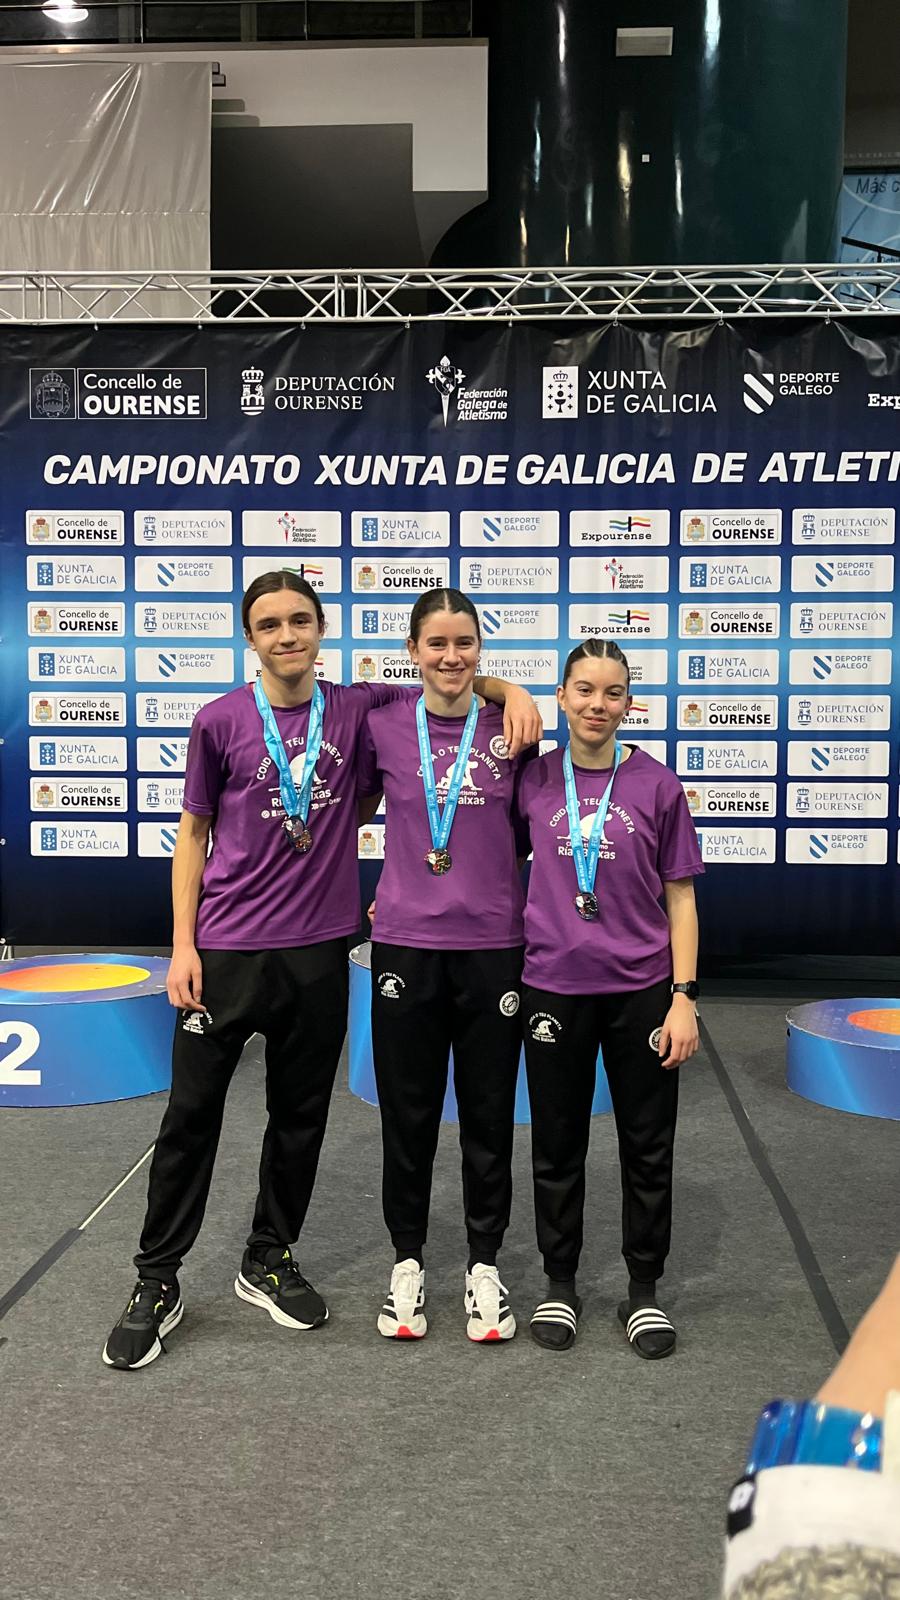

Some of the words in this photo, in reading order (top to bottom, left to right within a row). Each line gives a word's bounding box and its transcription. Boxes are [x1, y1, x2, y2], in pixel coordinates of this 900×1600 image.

[855, 178, 887, 193] Más
[83, 374, 157, 390] Concello
[162, 374, 182, 390] de
[275, 373, 395, 391] DEPUTACIÓN
[588, 371, 666, 389] XUNTA
[780, 373, 840, 382] DEPORTE
[457, 388, 507, 399] Federación
[780, 385, 833, 395] GALEGO
[84, 395, 200, 415] OURENSE
[275, 395, 363, 410] OURENSE
[457, 399, 496, 411] Galega
[587, 395, 615, 413] DE
[624, 395, 717, 413] GALICIA
[457, 410, 507, 420] Atletismo
[44, 455, 300, 485] CAMPIONATO
[314, 455, 446, 486] XUNTA
[456, 455, 508, 485] DE
[517, 452, 675, 484] GALICIA
[692, 452, 747, 483] DE
[57, 518, 95, 526] Concello
[98, 518, 107, 526] de
[162, 519, 225, 528] DEPUTACIÓN
[382, 520, 418, 529] XUNTA
[713, 517, 752, 526] Concello
[755, 517, 765, 526] de
[821, 517, 888, 526] DEPUTACIÓN
[57, 530, 117, 539] OURENSE
[162, 530, 208, 538] OURENSE
[382, 531, 395, 539] DE
[399, 531, 441, 539] GALICIA
[582, 532, 651, 542] Expourense
[713, 529, 774, 539] OURENSE
[57, 564, 94, 573] XUNTA
[383, 566, 421, 574] Concello
[424, 566, 433, 574] de
[488, 566, 552, 576] DEPUTACIÓN
[712, 565, 748, 574] XUNTA
[57, 575, 71, 584] DE
[74, 575, 116, 584] GALICIA
[383, 577, 442, 587] OURENSE
[488, 578, 534, 586] OURENSE
[711, 577, 724, 585] DE
[729, 576, 772, 585] GALICIA
[59, 610, 96, 618] Concello
[99, 610, 109, 618] de
[162, 611, 226, 620] DEPUTACIÓN
[382, 612, 410, 621] XUNT
[711, 611, 750, 620] Concello
[753, 611, 763, 620] de
[819, 611, 886, 621] DEPUTACIÓN
[59, 621, 118, 631] OURENSE
[382, 623, 395, 632] DE
[580, 625, 650, 634] Expourense
[711, 623, 772, 633] OURENSE
[59, 655, 94, 663] XUNTA
[487, 659, 551, 667] DEPUTACIÓN
[710, 658, 746, 666] XUNTA
[59, 666, 72, 674] DE
[75, 665, 117, 674] GALICIA
[709, 669, 722, 678] DE
[727, 669, 770, 677] GALICIA
[60, 700, 97, 708] Concello
[100, 700, 110, 708] de
[164, 702, 203, 710] DEPUTA
[709, 704, 749, 712] Concello
[751, 704, 761, 712] de
[817, 704, 884, 713] DEPUTACIÓN
[60, 711, 119, 721] OURENSE
[709, 714, 770, 724] OURENSE
[817, 715, 865, 723] OURENSE
[60, 745, 96, 753] XUNTA
[708, 749, 745, 758] XUNTA
[60, 755, 73, 764] DE
[76, 755, 119, 764] GALICIA
[257, 757, 272, 780] COID
[286, 737, 304, 748] TEU
[320, 741, 343, 766] ANETA
[469, 748, 501, 780] PLANETA
[708, 760, 721, 768] DE
[725, 760, 768, 768] GALICIA
[61, 785, 98, 793] Concello
[101, 785, 111, 793] de
[708, 790, 747, 798] Concello
[749, 790, 759, 798] de
[815, 791, 882, 801] DEPUTACIÓN
[61, 796, 120, 806] OURENSE
[458, 796, 485, 805] aixas
[708, 801, 769, 811] OURENSE
[61, 830, 96, 838] XUNTA
[61, 841, 74, 849] DE
[77, 840, 119, 849] GALICIA
[707, 836, 743, 844] XUNTA
[558, 846, 572, 856] Ría
[706, 847, 720, 856] DE
[724, 847, 767, 856] GALICIA
[0, 1021, 41, 1085] 2
